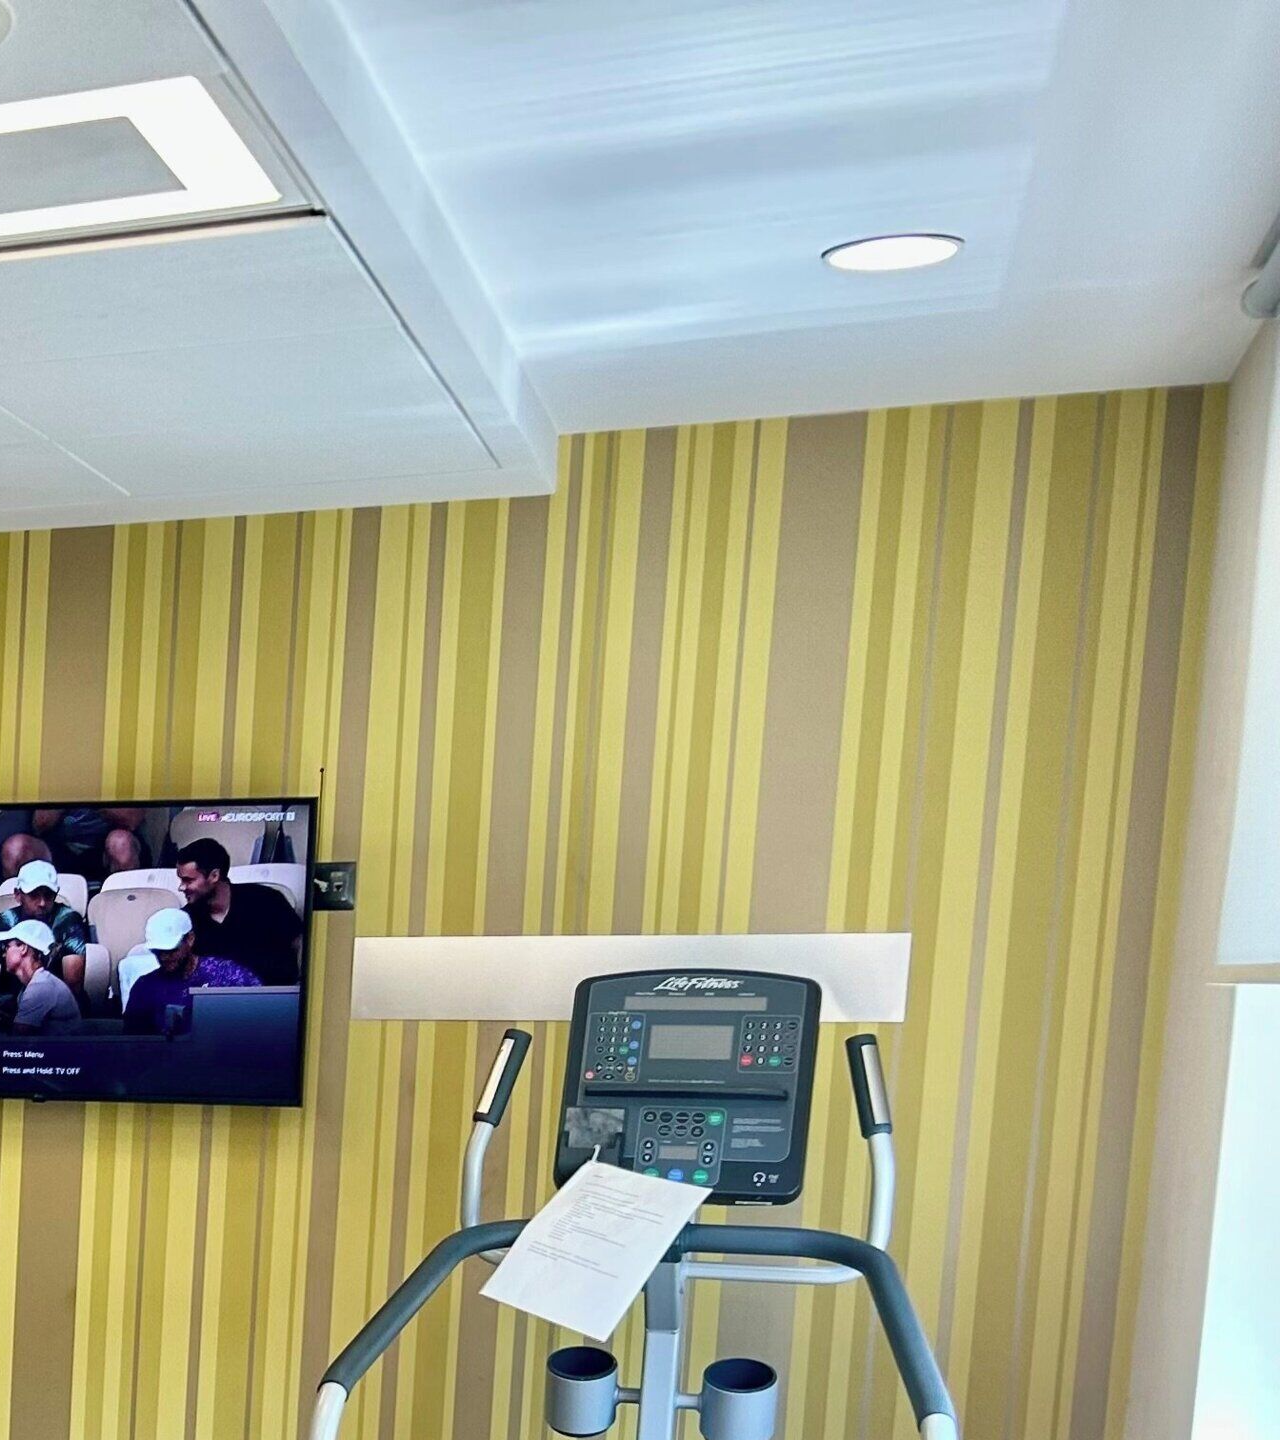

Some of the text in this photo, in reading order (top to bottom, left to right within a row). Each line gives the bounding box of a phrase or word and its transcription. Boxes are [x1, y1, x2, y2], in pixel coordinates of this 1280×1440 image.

[198, 812, 218, 822] LIVE
[224, 811, 285, 822] EUROSPORT
[24, 1050, 45, 1058] Menu
[2, 1066, 21, 1074] Press
[22, 1066, 36, 1074] and
[55, 1067, 65, 1075] TV
[66, 1067, 81, 1075] OFF
